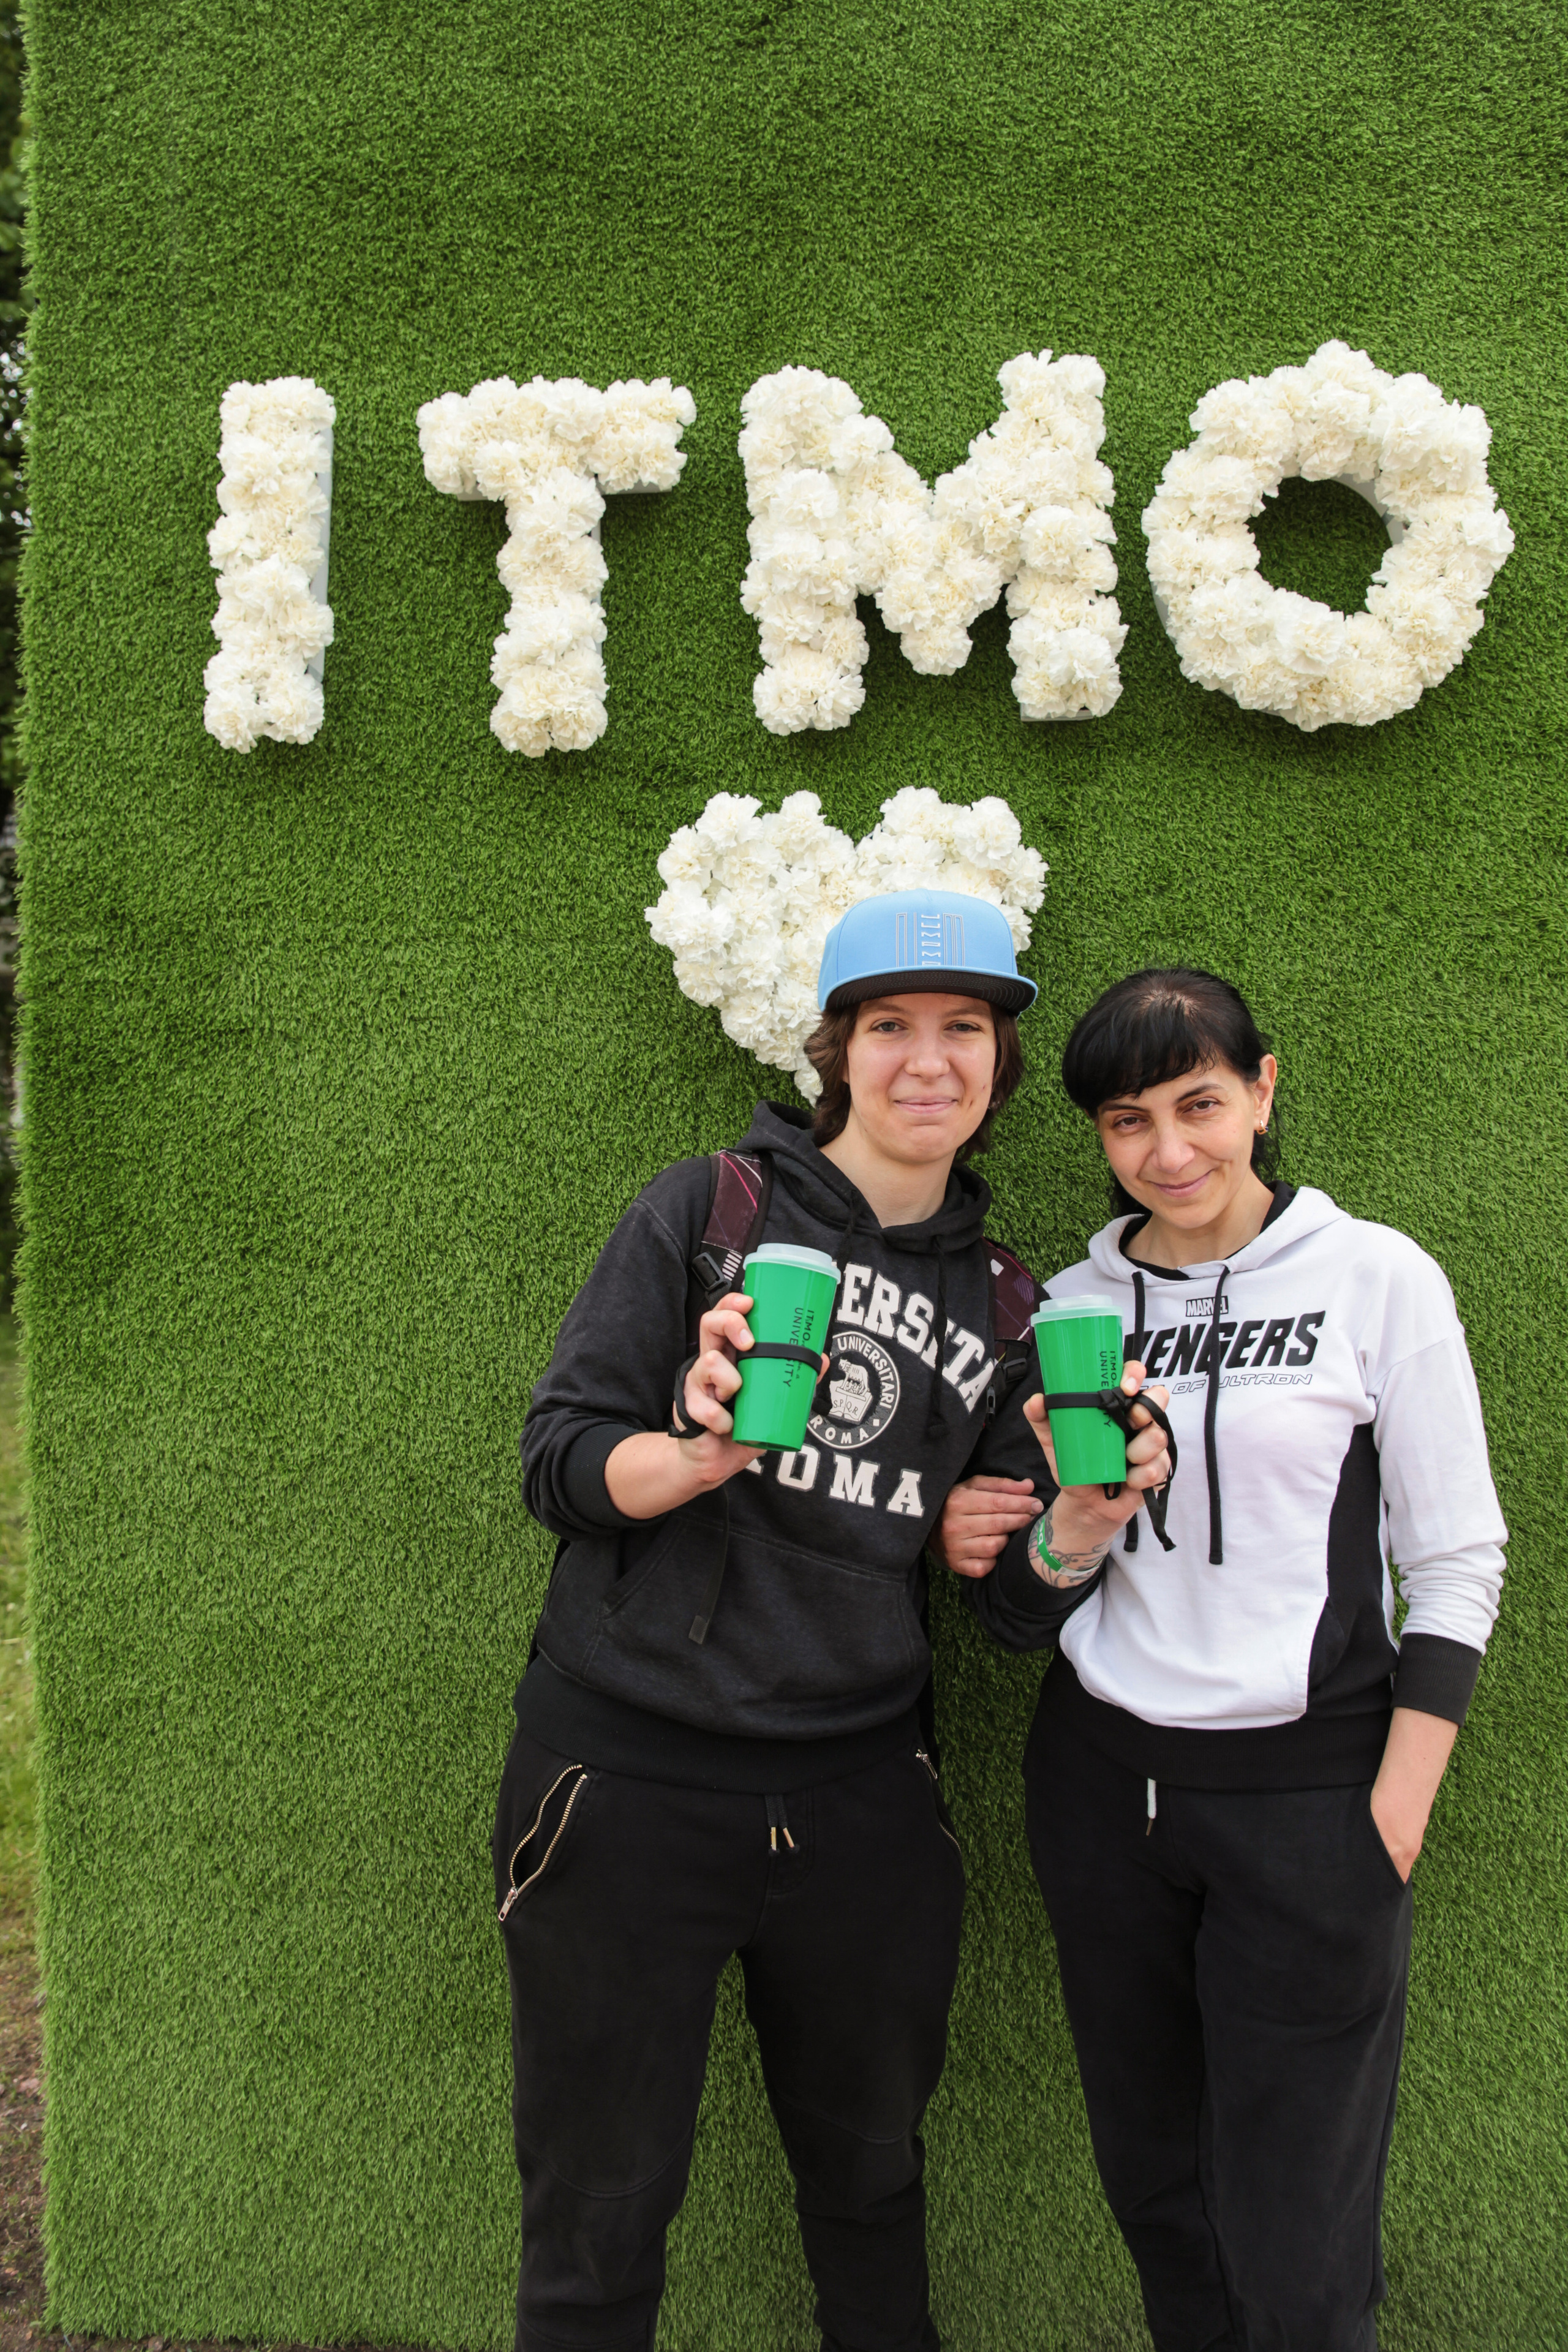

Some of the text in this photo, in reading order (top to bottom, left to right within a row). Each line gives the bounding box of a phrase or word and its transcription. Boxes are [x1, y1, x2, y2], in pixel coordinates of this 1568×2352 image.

[204, 339, 1515, 757] ITMO
[837, 1336, 895, 1409] UNIVERSITARI
[1172, 1379, 1207, 1395] OF
[810, 1414, 869, 1444] ROMA
[745, 1444, 924, 1518] OMA
